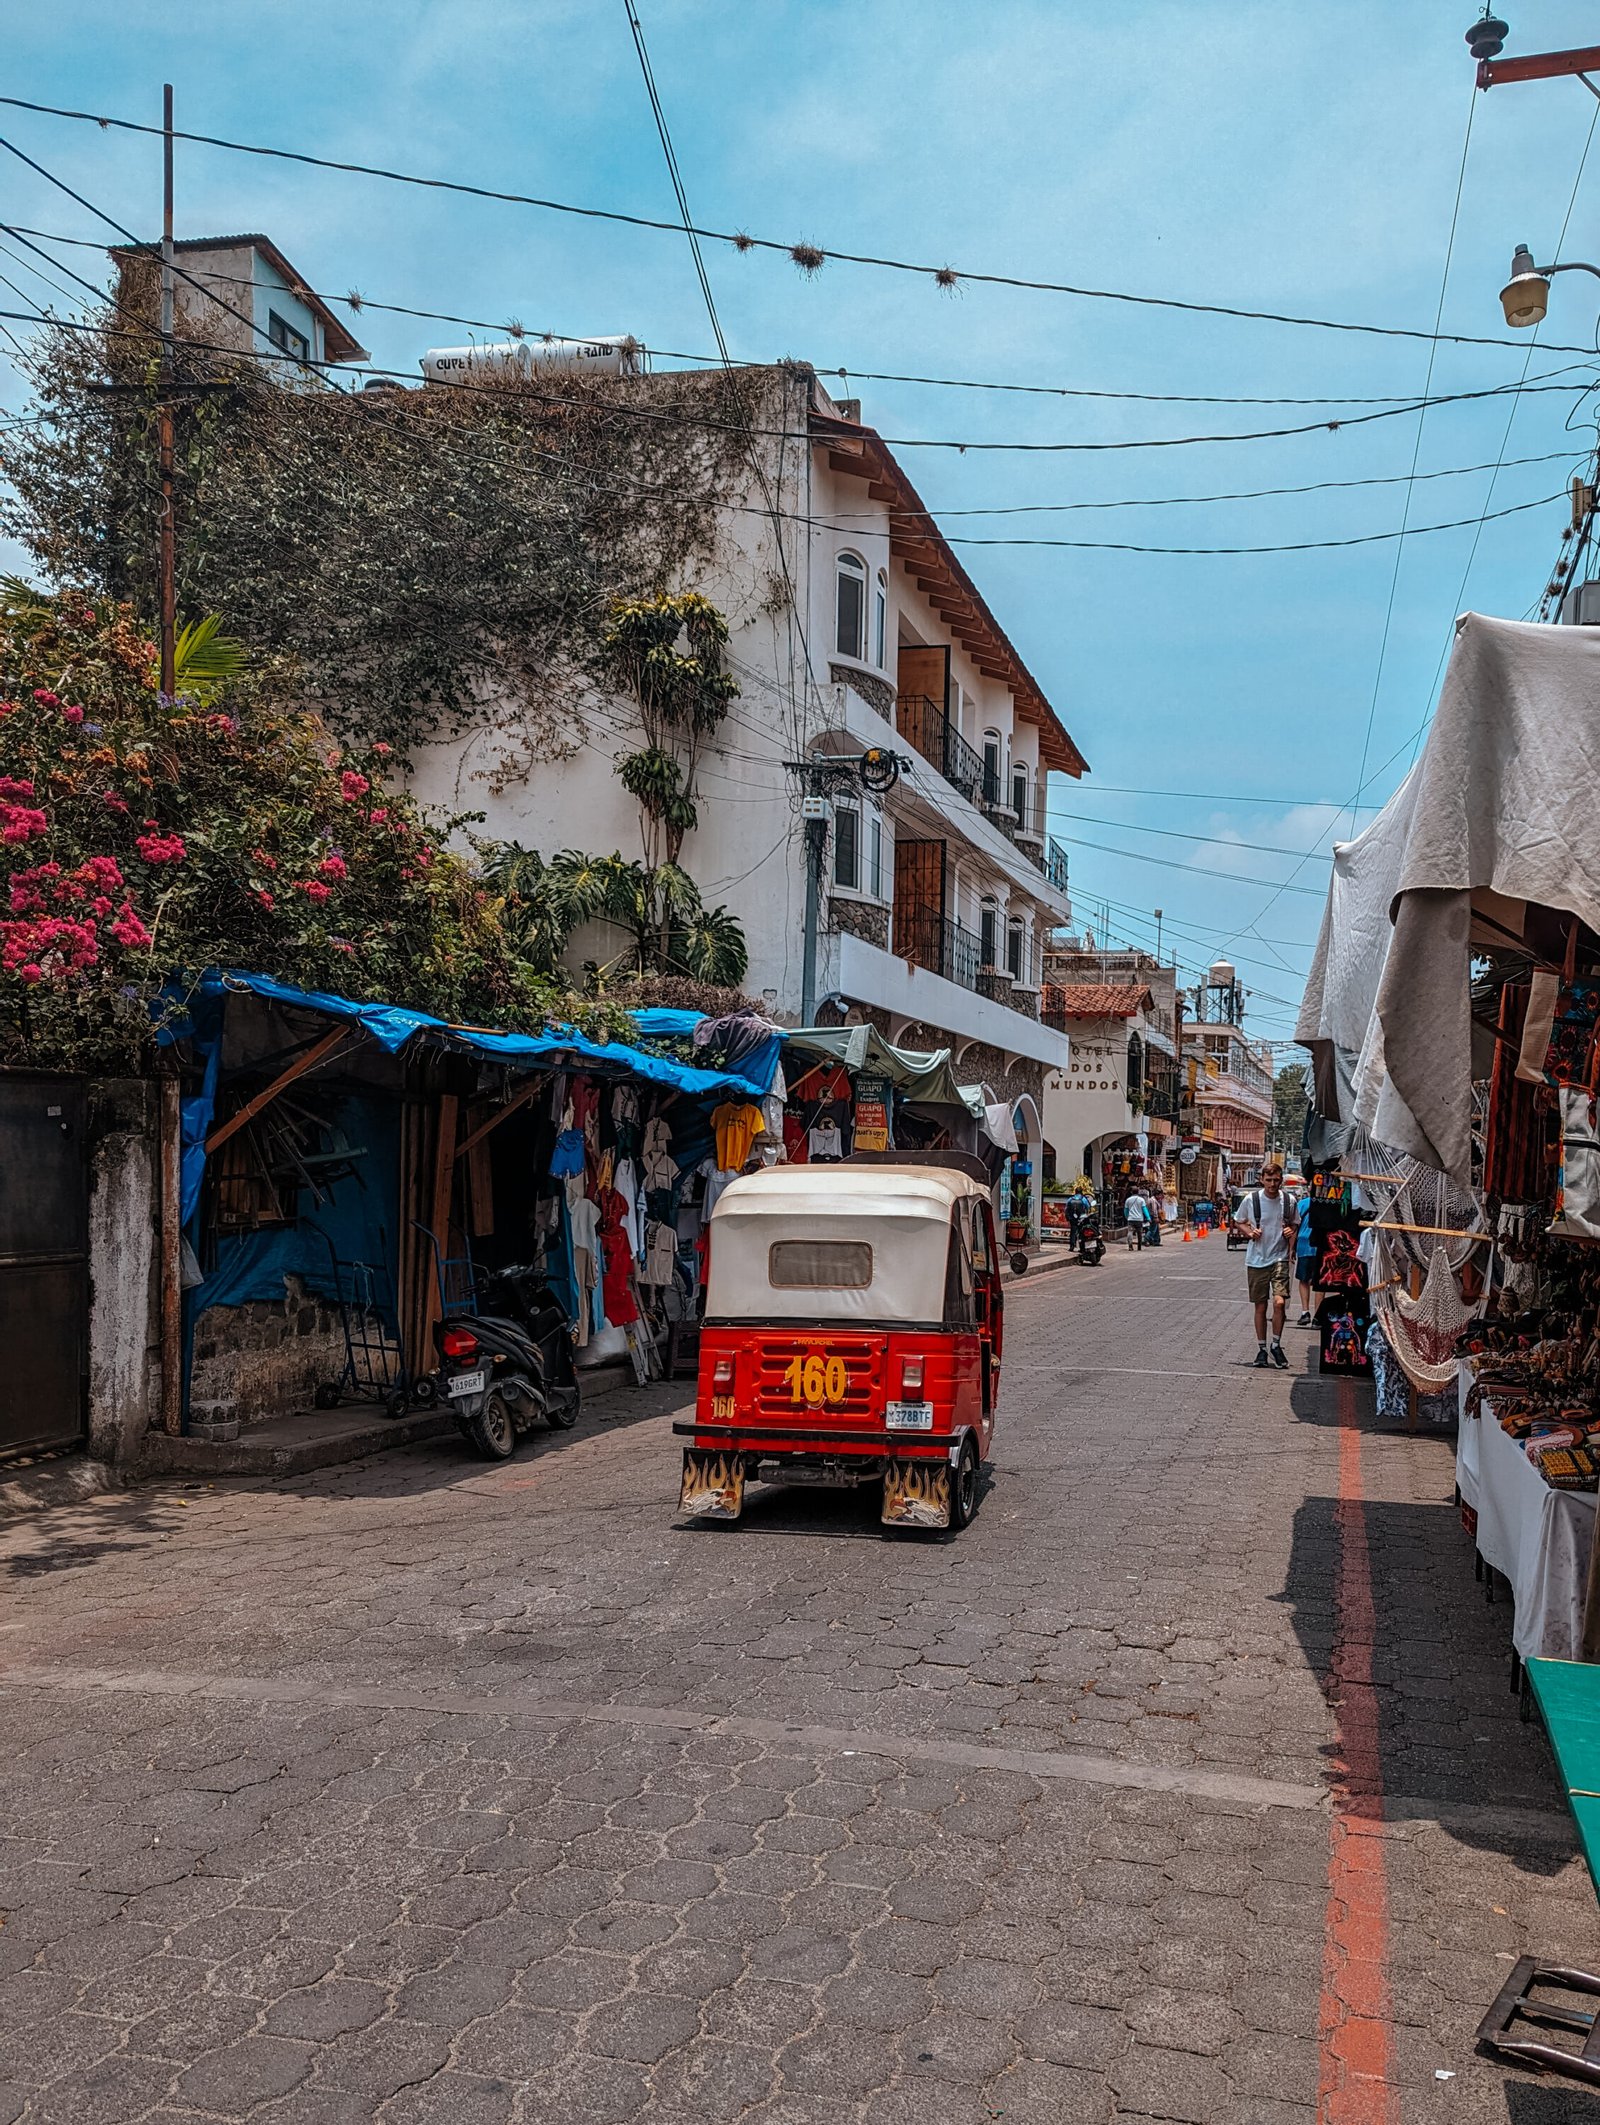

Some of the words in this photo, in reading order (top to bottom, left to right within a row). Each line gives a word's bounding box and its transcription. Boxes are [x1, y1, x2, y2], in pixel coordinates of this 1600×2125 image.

[1071, 1046, 1113, 1056] OTEL
[1071, 1063, 1103, 1073] DOS
[1050, 1080, 1119, 1090] MUNDOS
[1315, 1185, 1351, 1200] MAYA
[453, 1377, 482, 1391] 619GRT
[785, 1355, 846, 1405] 160
[712, 1395, 735, 1419] 160
